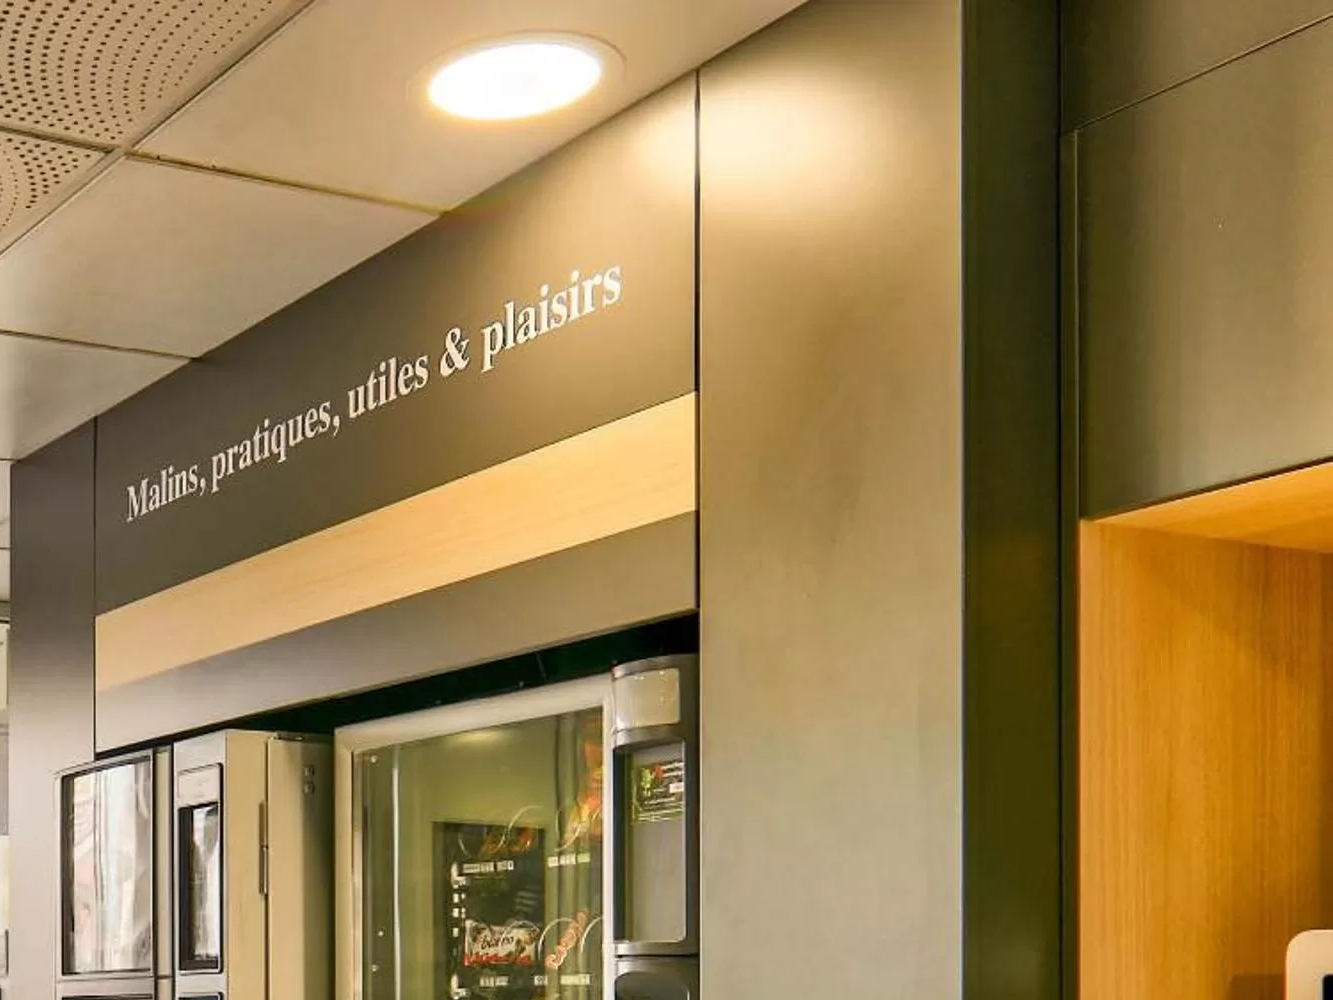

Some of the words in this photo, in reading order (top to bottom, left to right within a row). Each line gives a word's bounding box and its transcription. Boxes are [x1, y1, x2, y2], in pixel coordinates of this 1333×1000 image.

[125, 464, 208, 523] Malins,
[210, 398, 341, 494] pratiques,
[347, 353, 430, 420] utiles
[439, 326, 470, 378] &
[481, 264, 623, 374] plaisirs
